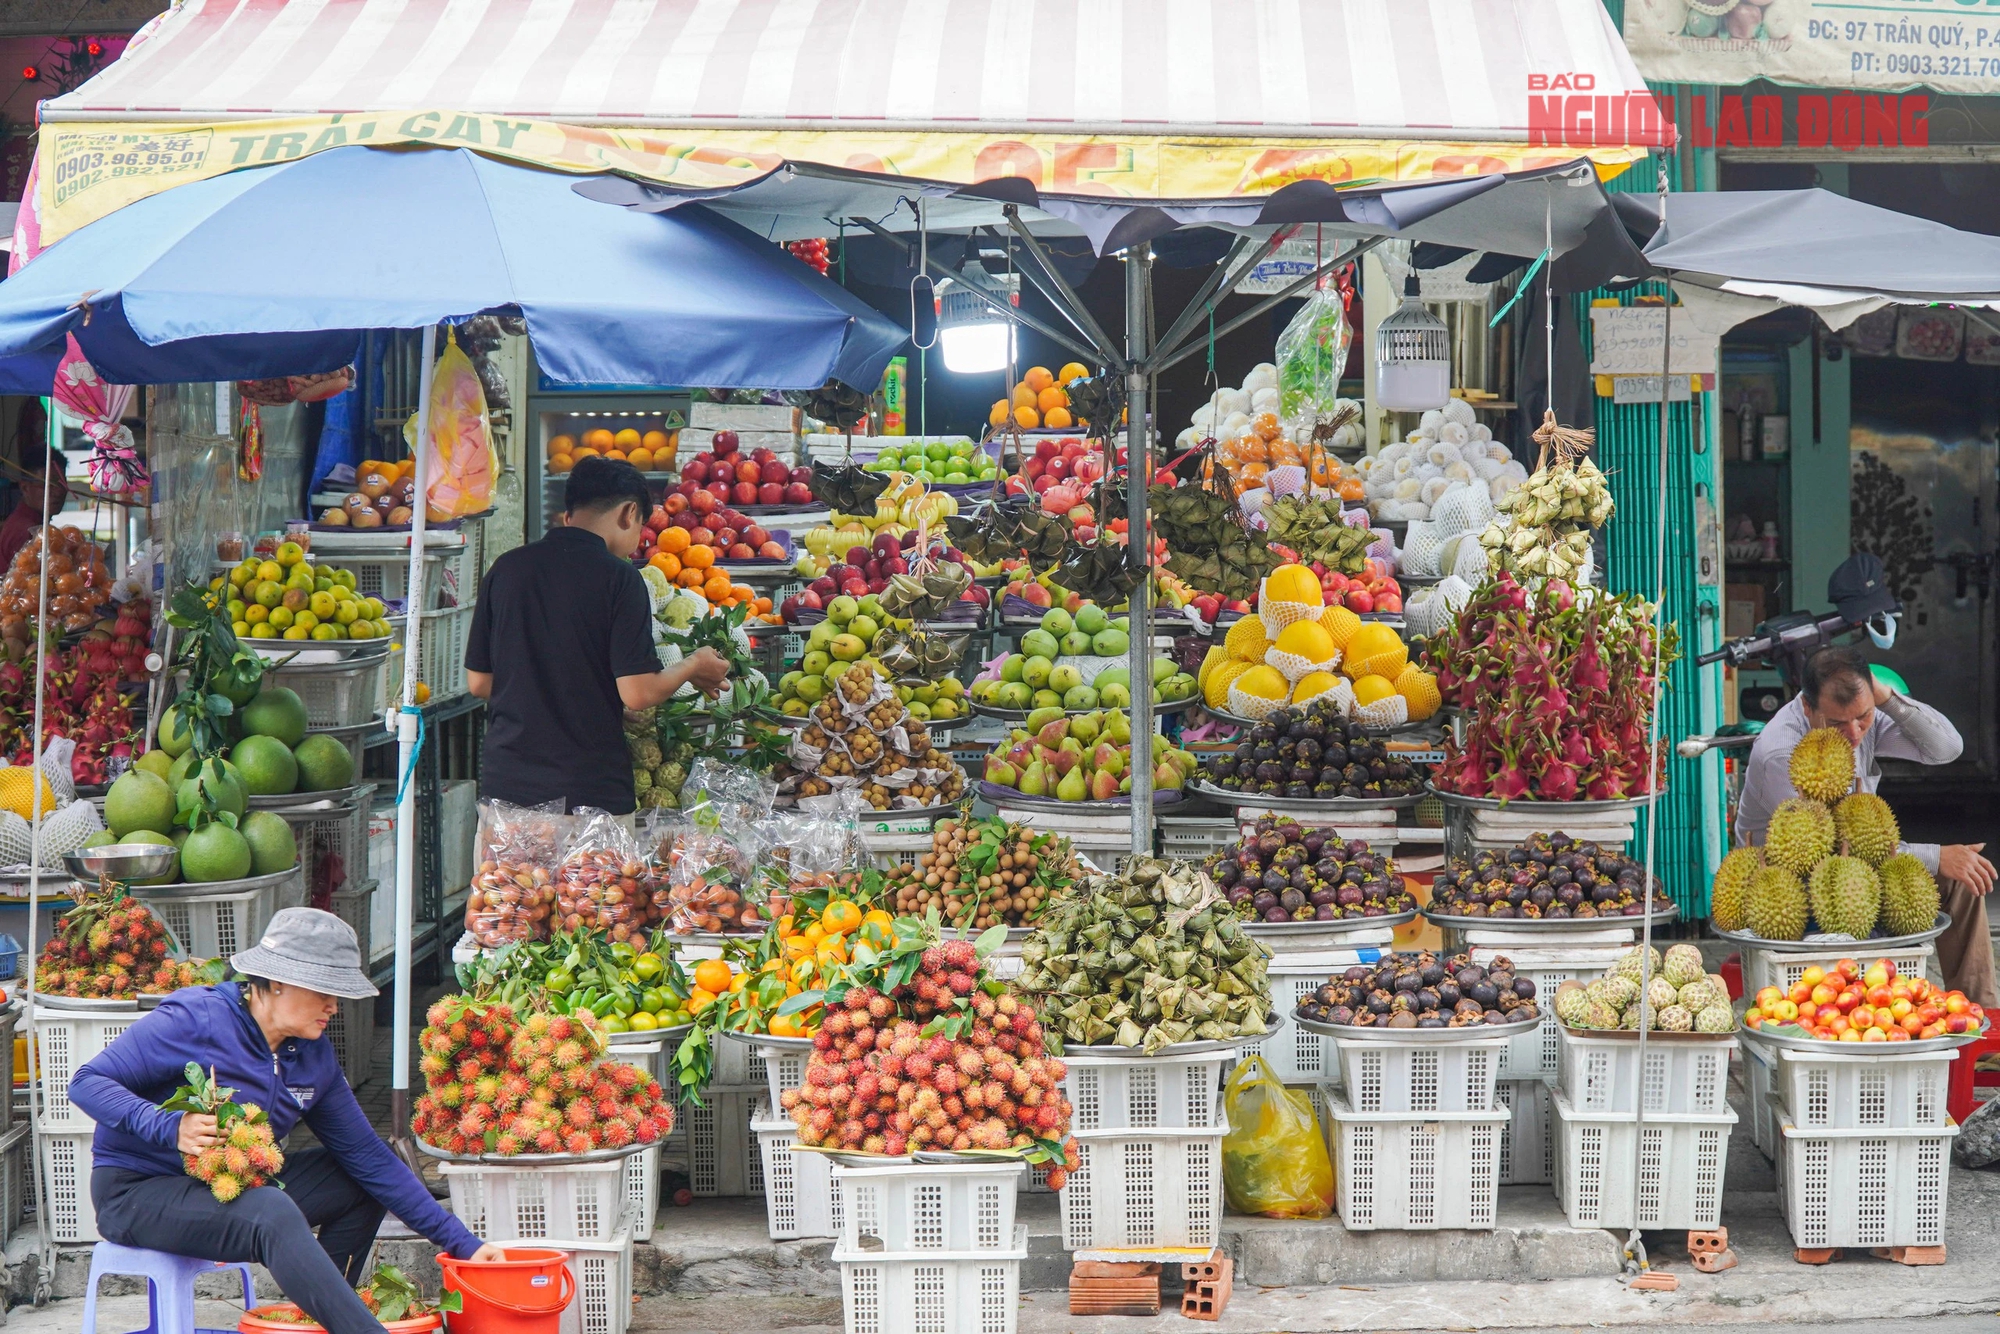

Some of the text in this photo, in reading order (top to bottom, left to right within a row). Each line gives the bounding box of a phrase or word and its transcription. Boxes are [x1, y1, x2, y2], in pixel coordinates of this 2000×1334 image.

[1808, 19, 1838, 40] ĐC:
[1845, 21, 1868, 41] 97
[1873, 15, 1922, 44] TRẦN
[1851, 52, 2000, 77] ĐT: 0903.321.70
[56, 151, 205, 185] 0903.96.95.01
[56, 162, 201, 204] 0902.982.521
[1599, 335, 1689, 353] 093960903
